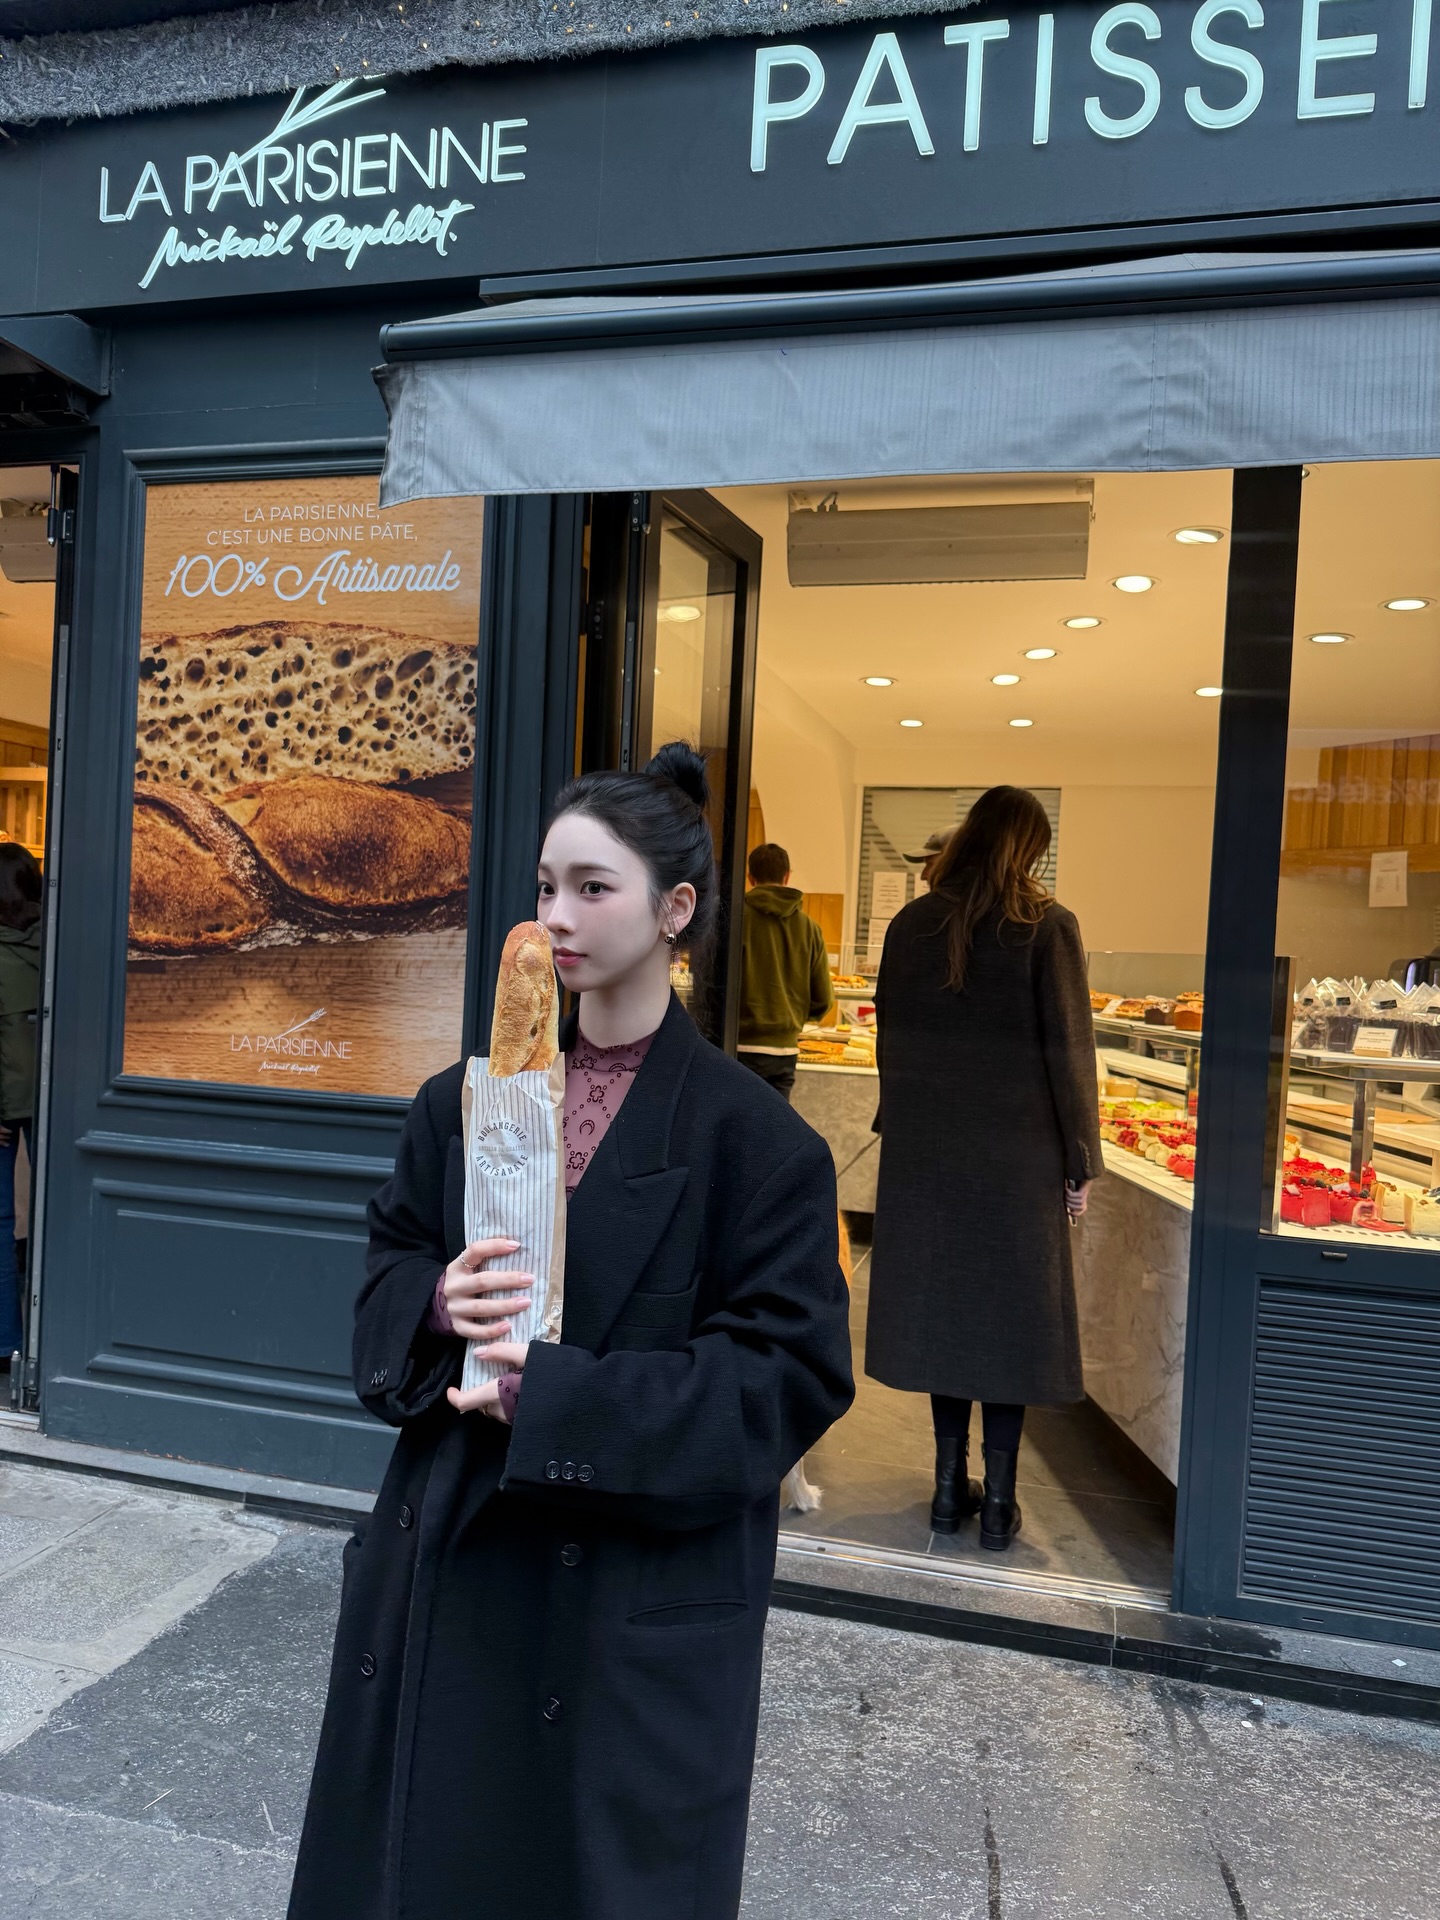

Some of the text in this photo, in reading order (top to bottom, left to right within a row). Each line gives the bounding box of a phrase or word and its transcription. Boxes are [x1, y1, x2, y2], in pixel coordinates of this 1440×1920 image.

[98, 118, 529, 223] LA PARISIENNE
[138, 214, 303, 289] Mickaël
[244, 503, 380, 523] LA PARISIENNE,
[206, 521, 419, 546] C'EST UNE BONNE PÂTE,
[163, 549, 461, 606] 100% Artisanale
[231, 1035, 353, 1060] LA PARISIENNE
[477, 1121, 527, 1142] BOULANGERIE
[476, 1154, 529, 1177] ARTISANALE
